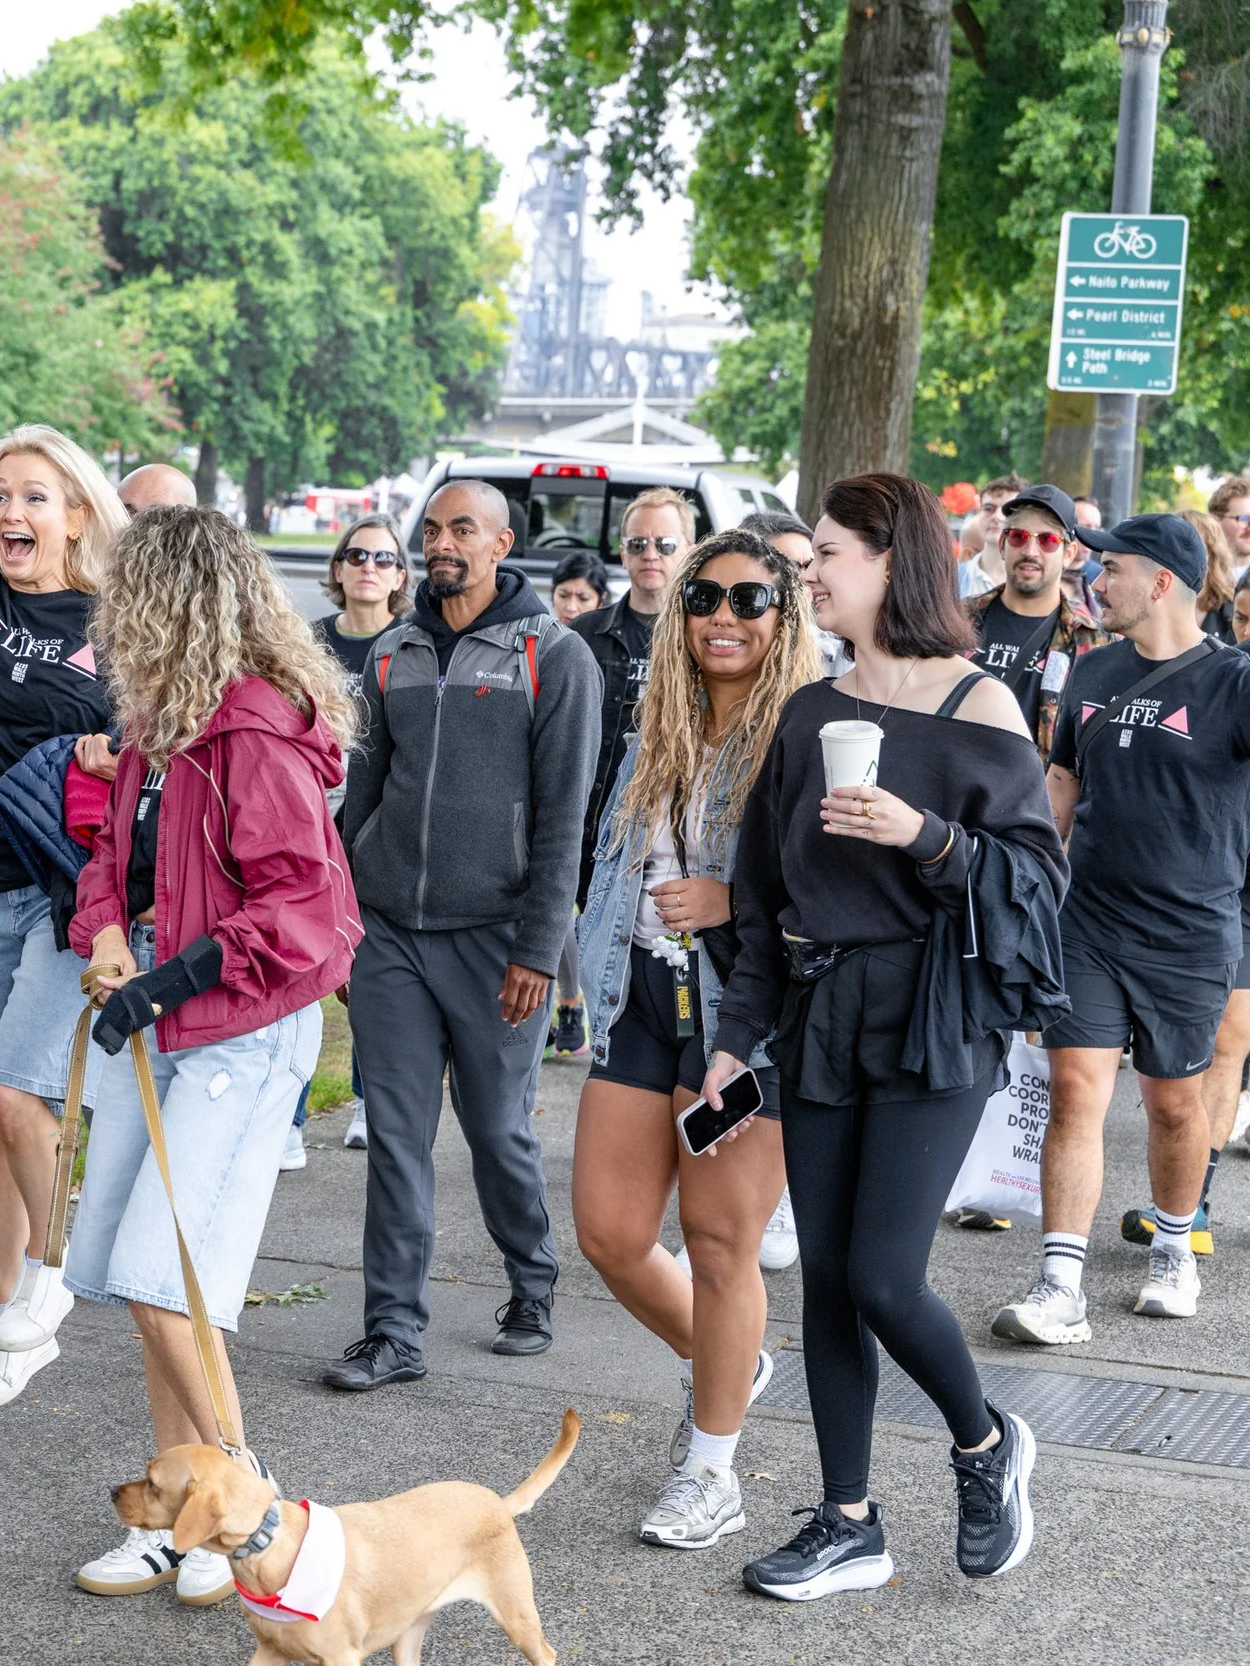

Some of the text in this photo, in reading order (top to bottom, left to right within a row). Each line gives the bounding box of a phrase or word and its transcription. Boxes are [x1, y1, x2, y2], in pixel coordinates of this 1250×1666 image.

[1089, 275, 1170, 292] Naito Parkway
[1086, 308, 1165, 324] Pearl District
[1083, 347, 1151, 365] Steel Bridge
[1082, 361, 1108, 374] Path
[0, 632, 61, 663] LIFE
[1131, 698, 1150, 706] ALKS
[1021, 1073, 1050, 1092] CON
[1009, 1085, 1049, 1105] COOR
[1021, 1102, 1049, 1120] PRO
[1007, 1114, 1047, 1133] DON'
[1023, 1134, 1042, 1149] SH
[1013, 1145, 1041, 1164] WRA
[817, 1544, 836, 1560] BROO
